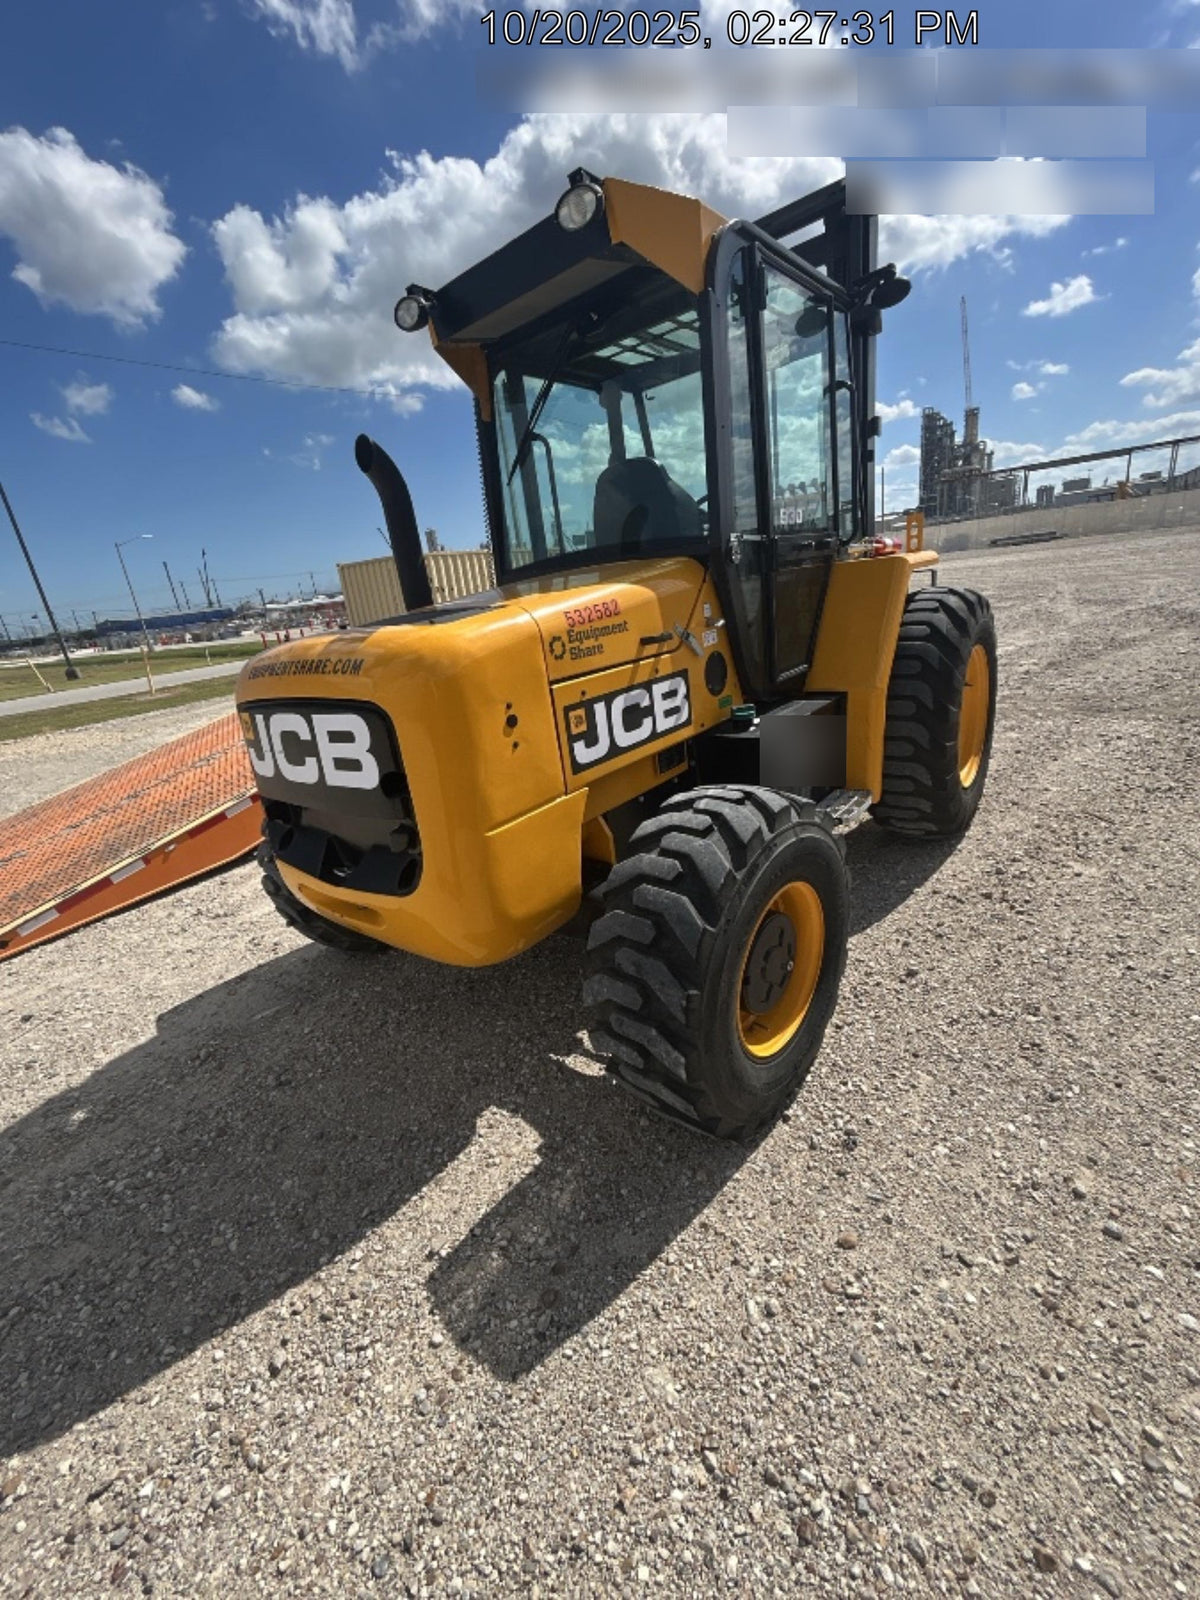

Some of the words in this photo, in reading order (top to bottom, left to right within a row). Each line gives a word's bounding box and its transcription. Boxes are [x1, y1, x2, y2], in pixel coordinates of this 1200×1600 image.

[563, 598, 621, 629] 532582
[566, 619, 630, 645] Equipment
[568, 642, 605, 661] Share
[573, 676, 690, 765] JCB
[249, 712, 380, 790] JCB
